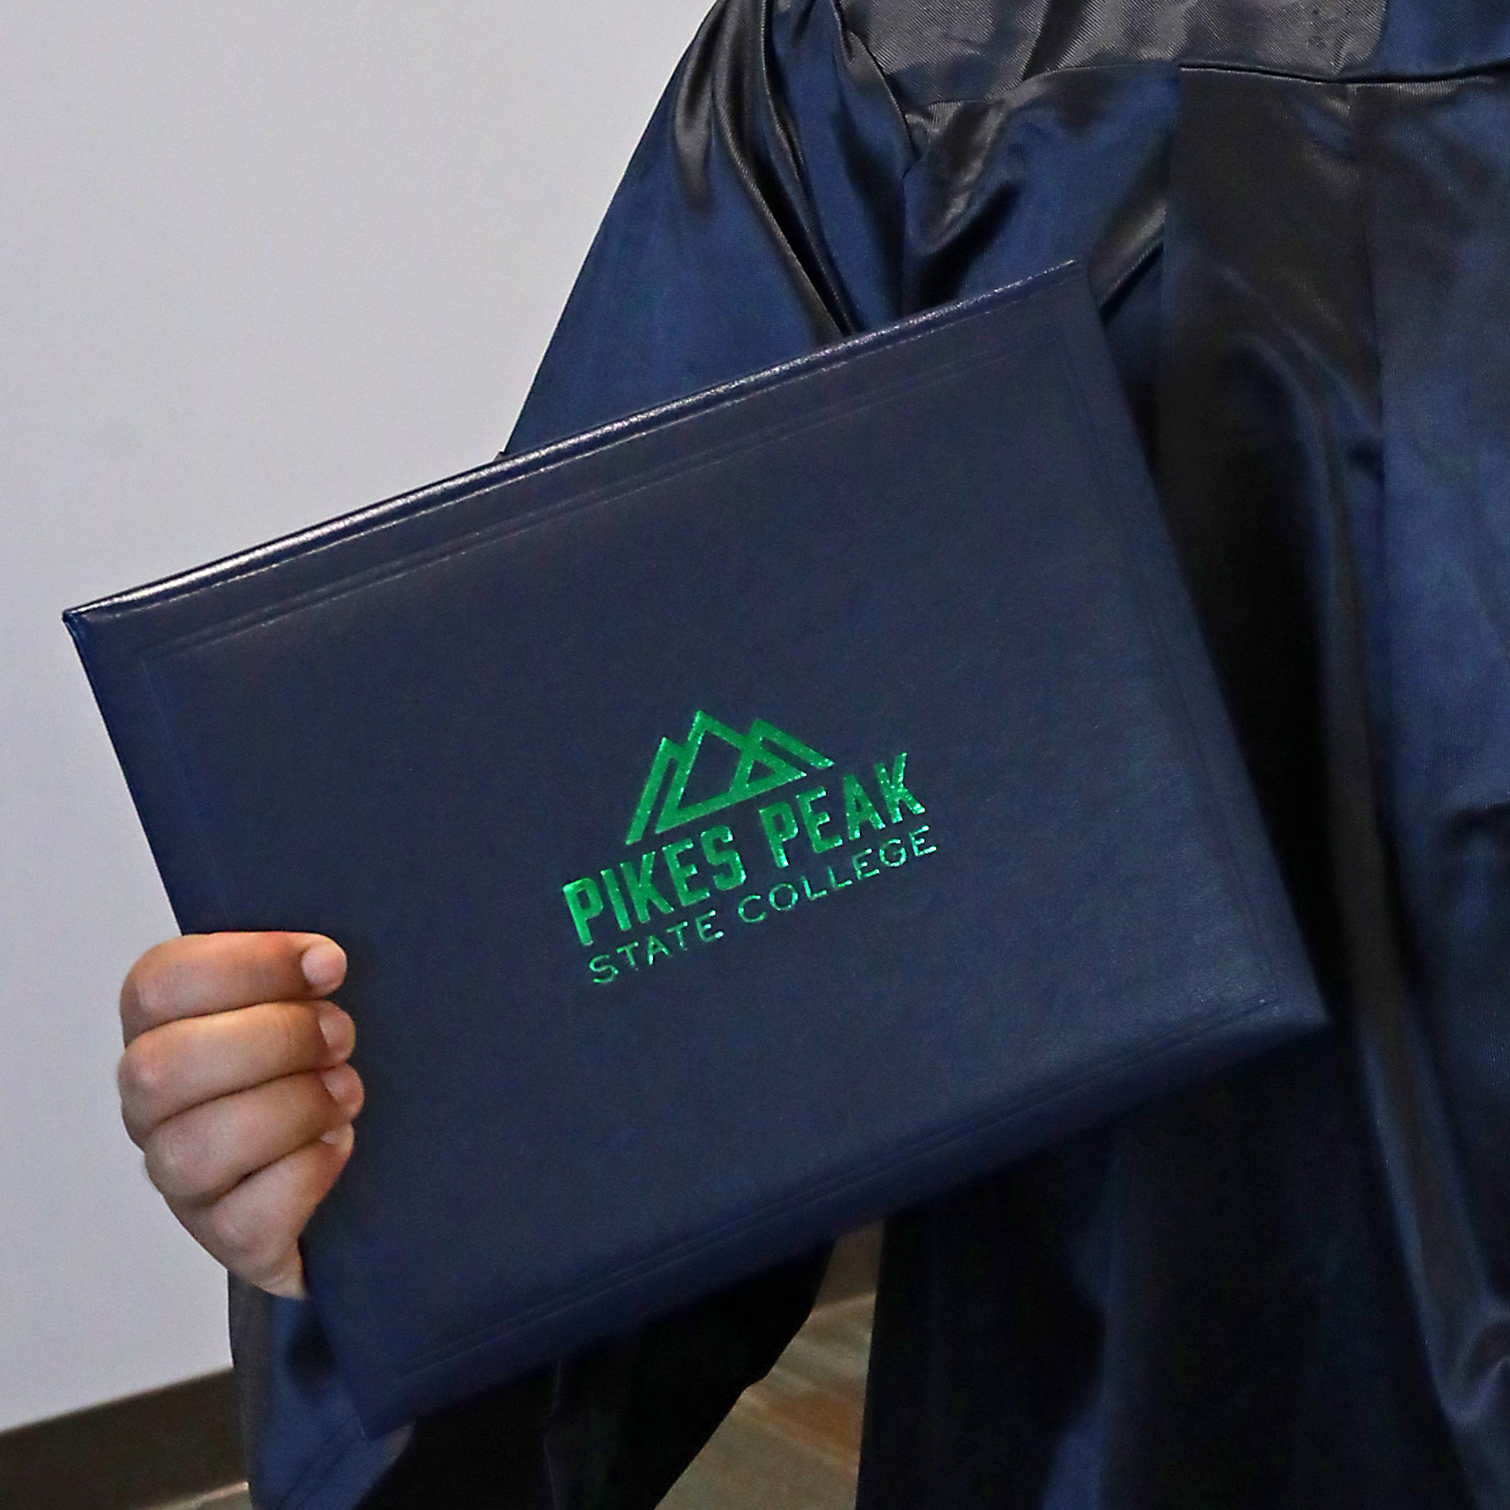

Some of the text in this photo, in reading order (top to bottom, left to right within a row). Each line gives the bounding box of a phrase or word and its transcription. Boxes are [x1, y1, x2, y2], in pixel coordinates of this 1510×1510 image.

[563, 752, 926, 947] PIKES PEAK
[589, 824, 938, 984] STATE COLLEGE
